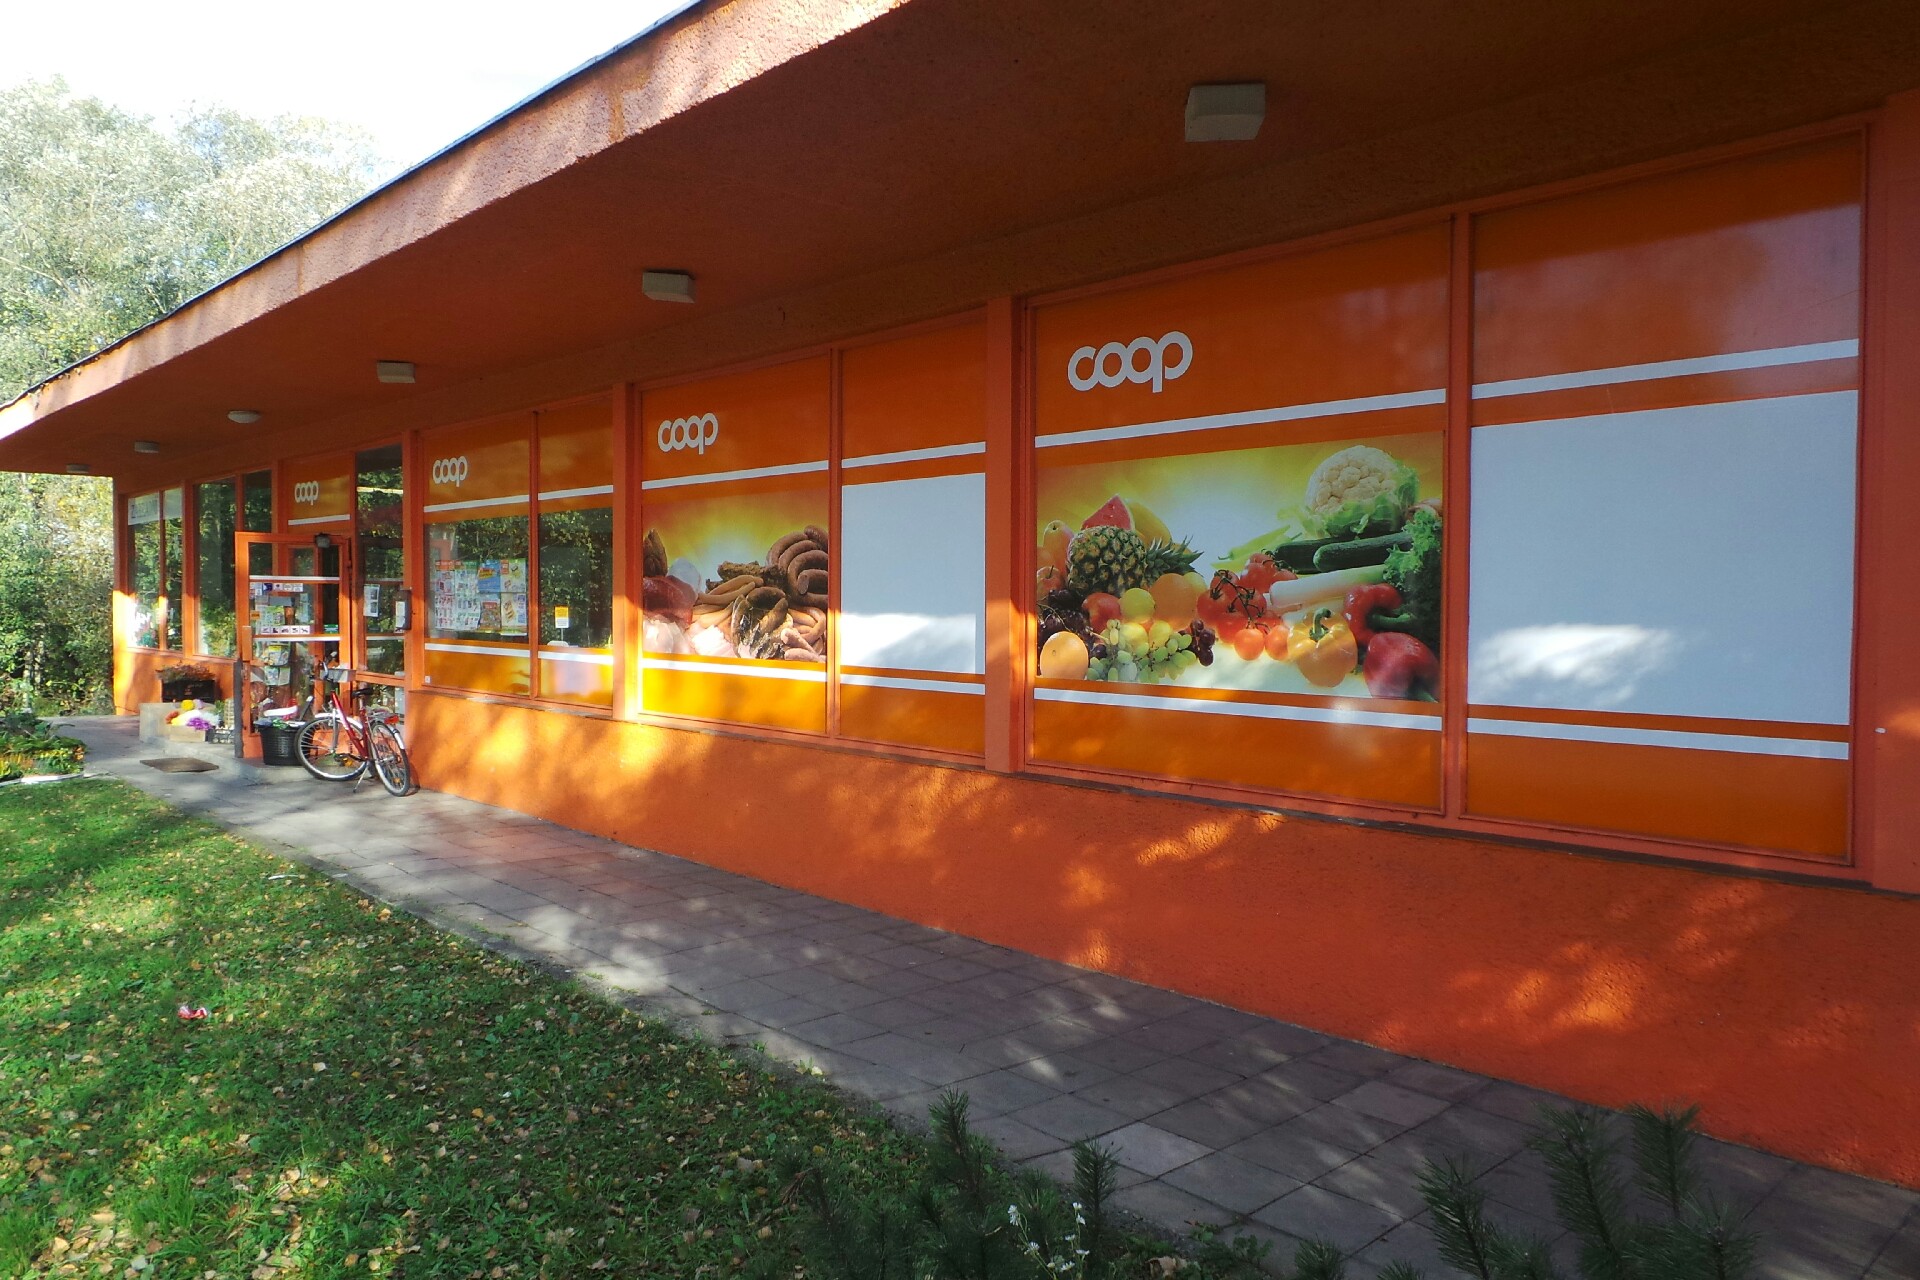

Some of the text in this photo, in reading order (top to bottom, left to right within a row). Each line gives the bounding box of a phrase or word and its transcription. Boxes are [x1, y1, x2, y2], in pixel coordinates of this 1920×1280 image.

[1067, 331, 1193, 393] coop
[658, 413, 718, 455] coop
[433, 456, 468, 487] coop
[295, 481, 319, 506] coop
